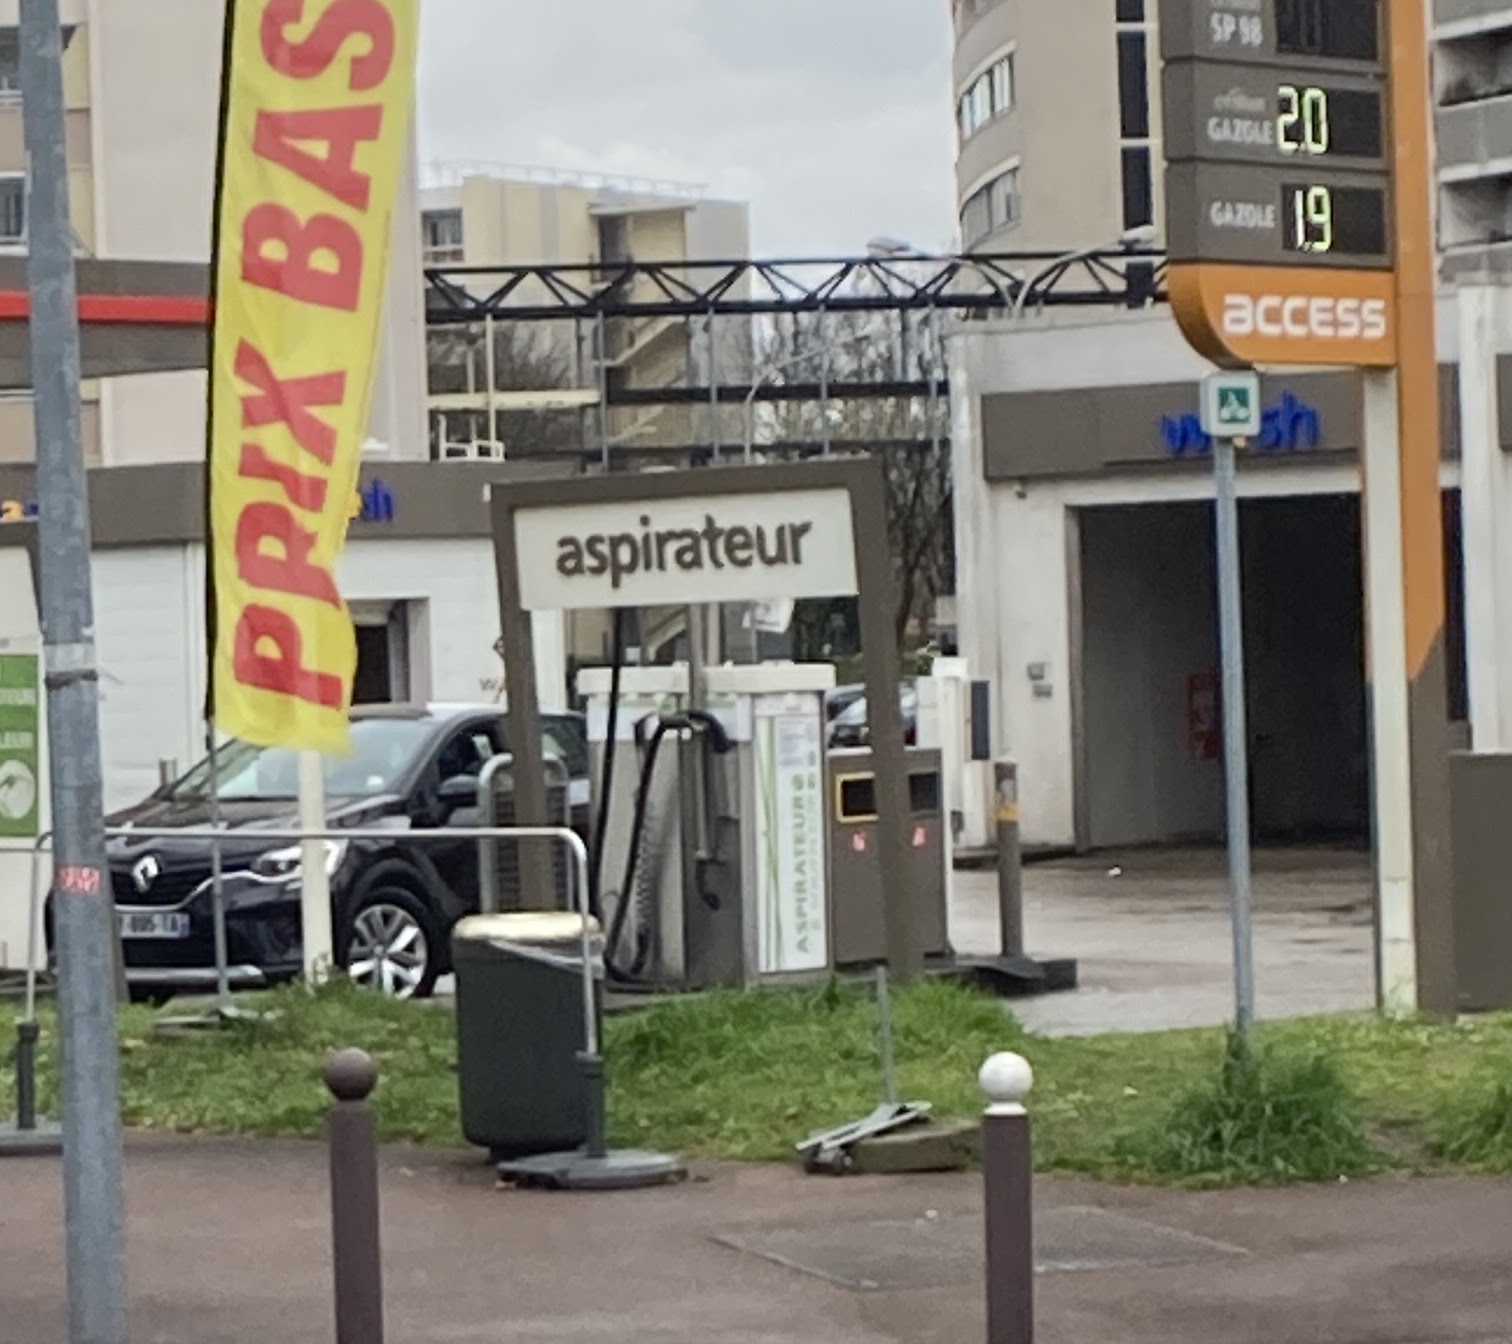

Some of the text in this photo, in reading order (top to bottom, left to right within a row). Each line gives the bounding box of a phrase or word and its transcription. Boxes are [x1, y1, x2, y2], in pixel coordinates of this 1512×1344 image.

[1210, 11, 1237, 44] SP
[1206, 116, 1274, 145] GAZOLE
[1209, 201, 1276, 229] GAZOLE
[1160, 390, 1320, 455] wsh
[233, 336, 347, 711] PRIX
[556, 513, 813, 590] aspirateur
